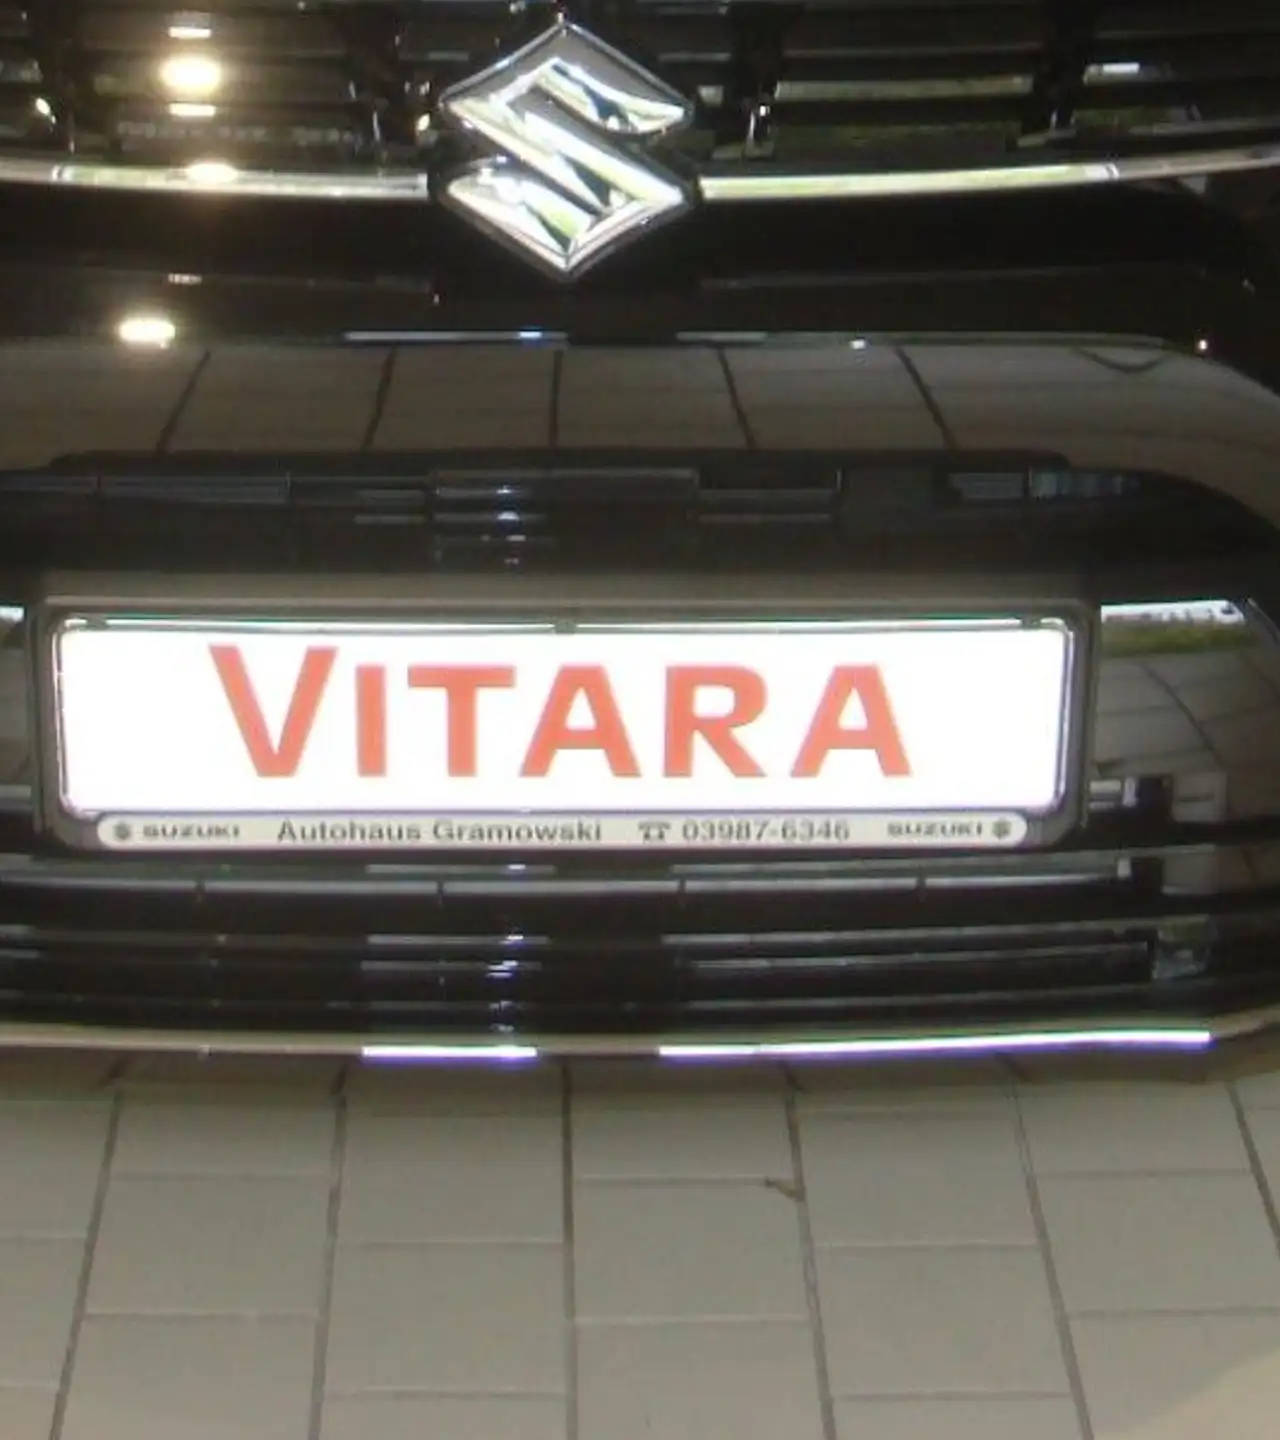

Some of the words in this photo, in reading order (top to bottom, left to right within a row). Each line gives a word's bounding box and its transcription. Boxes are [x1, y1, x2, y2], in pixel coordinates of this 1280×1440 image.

[208, 645, 912, 777] VITARA
[143, 824, 240, 838] SUZUKI
[277, 819, 422, 842] Autohaus
[432, 818, 602, 842] Gramowski
[682, 820, 851, 841] 03987-6346
[887, 822, 983, 837] SUZUKI
